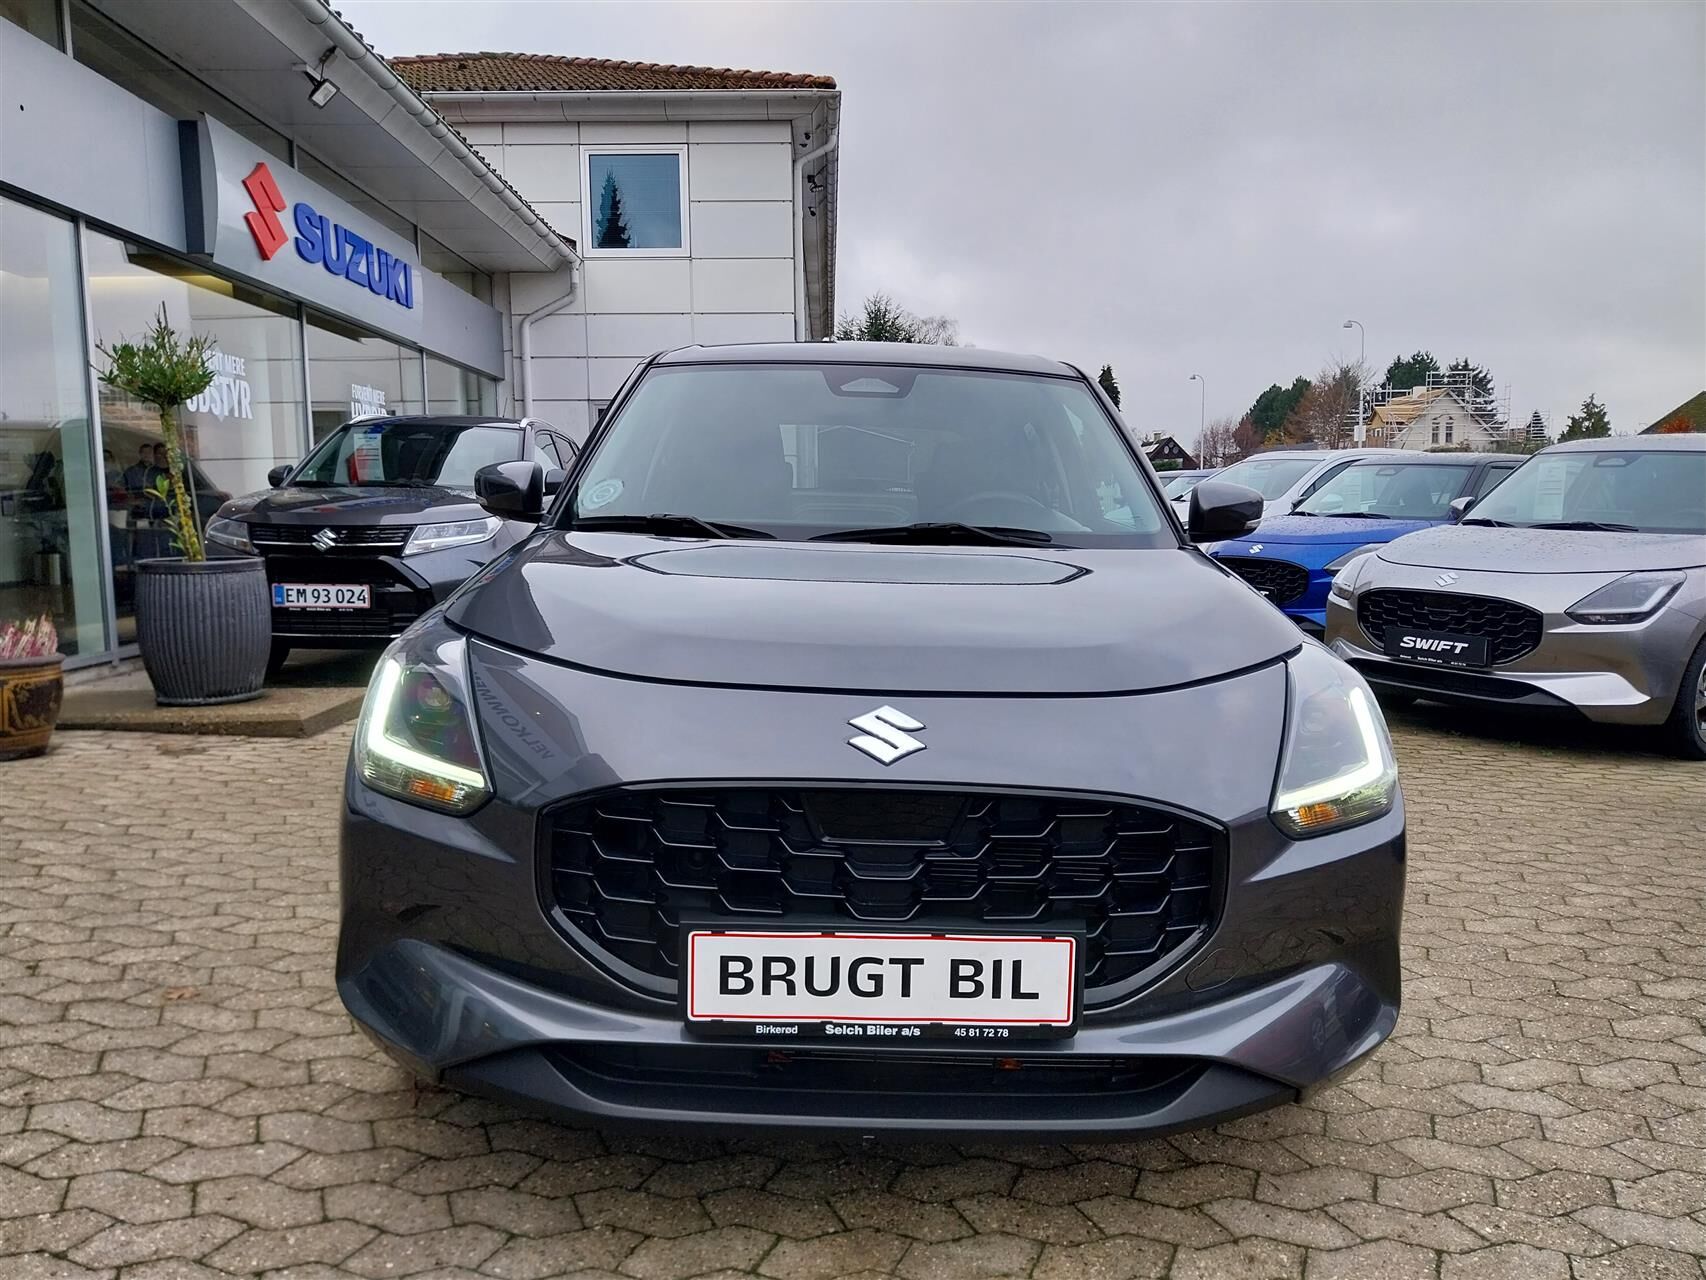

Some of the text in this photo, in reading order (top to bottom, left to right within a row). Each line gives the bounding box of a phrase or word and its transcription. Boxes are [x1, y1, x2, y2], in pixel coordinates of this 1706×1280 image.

[293, 202, 414, 309] SUZUKI
[285, 588, 367, 604] EM 93 024
[1399, 636, 1469, 654] SWIFT
[719, 955, 1040, 1000] BRUGT BIL
[755, 1024, 1009, 1038] Birkerød Selch Biler a/s 45 81 72 78
